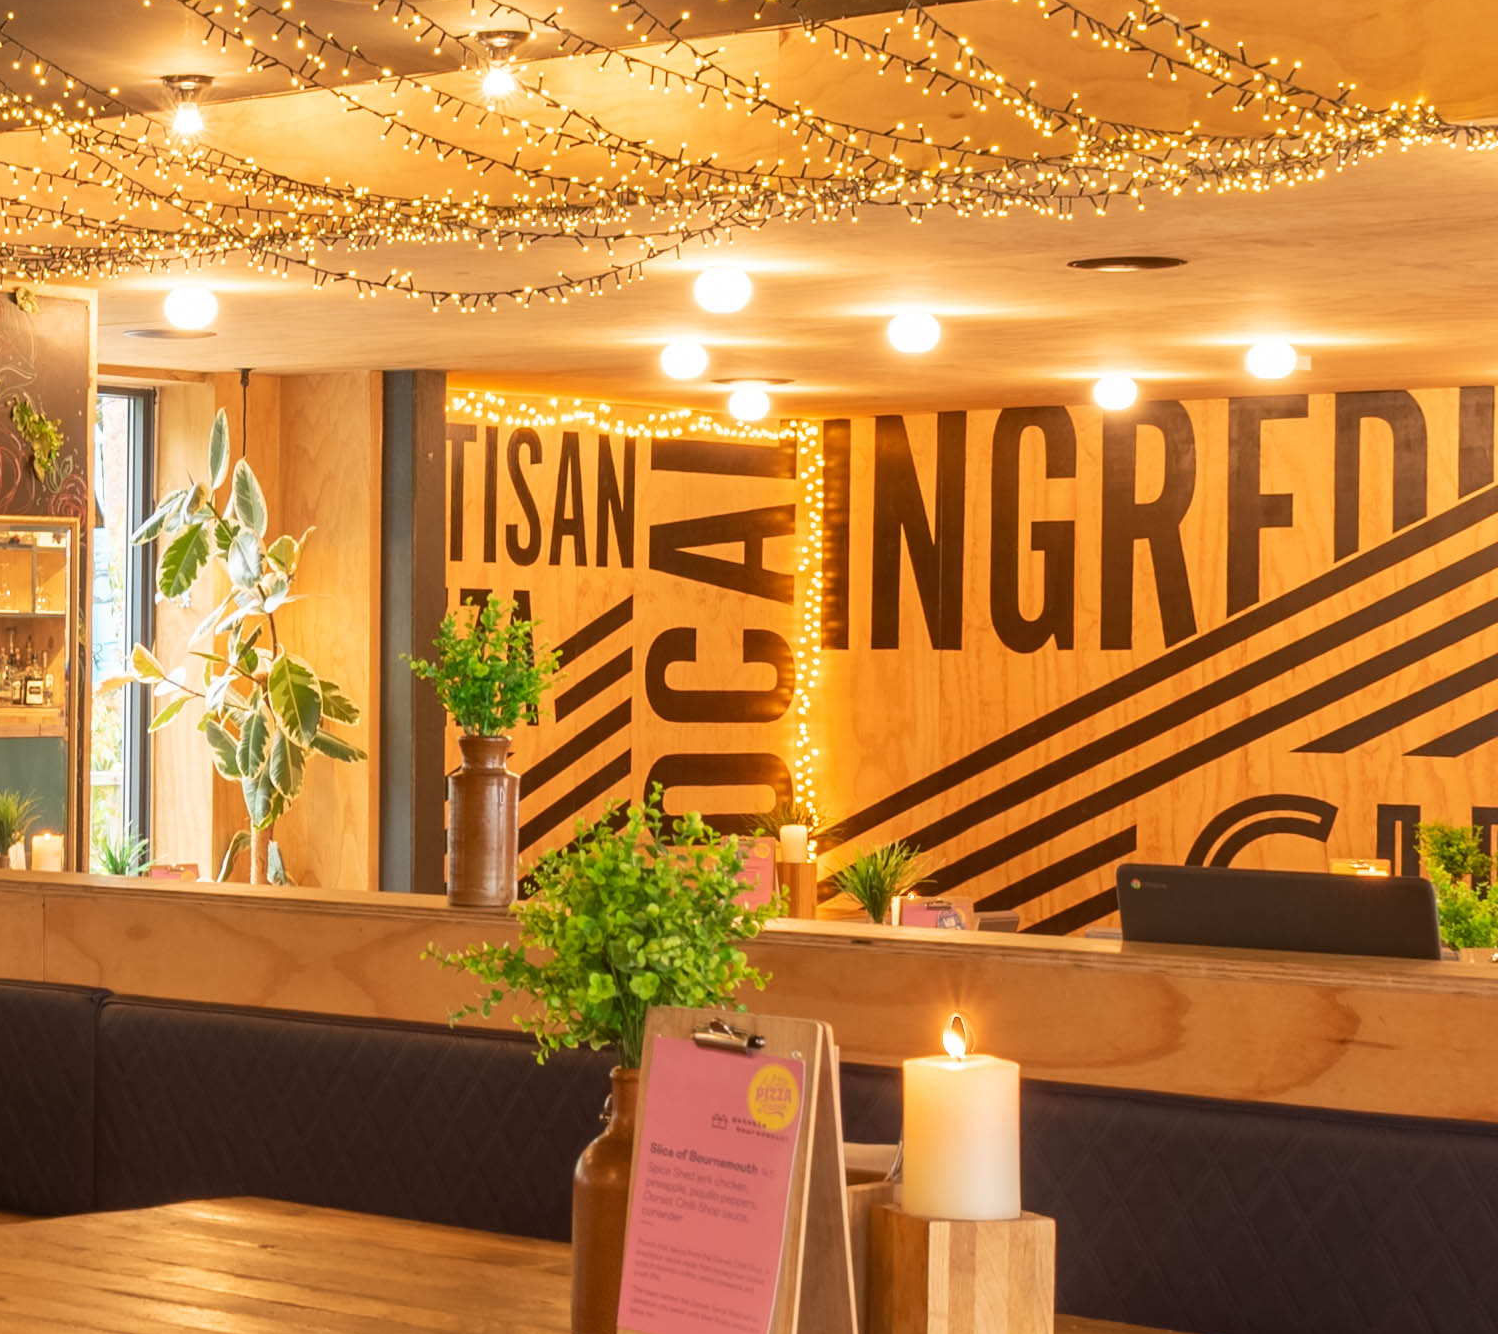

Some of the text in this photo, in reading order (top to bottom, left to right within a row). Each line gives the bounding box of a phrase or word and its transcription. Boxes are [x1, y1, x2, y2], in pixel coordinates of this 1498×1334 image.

[445, 423, 636, 568] TISAN
[756, 1087, 792, 1103] PIZZA
[650, 1141, 674, 1158] Slice
[676, 1149, 688, 1160] of
[689, 1149, 758, 1174] Bournemouth
